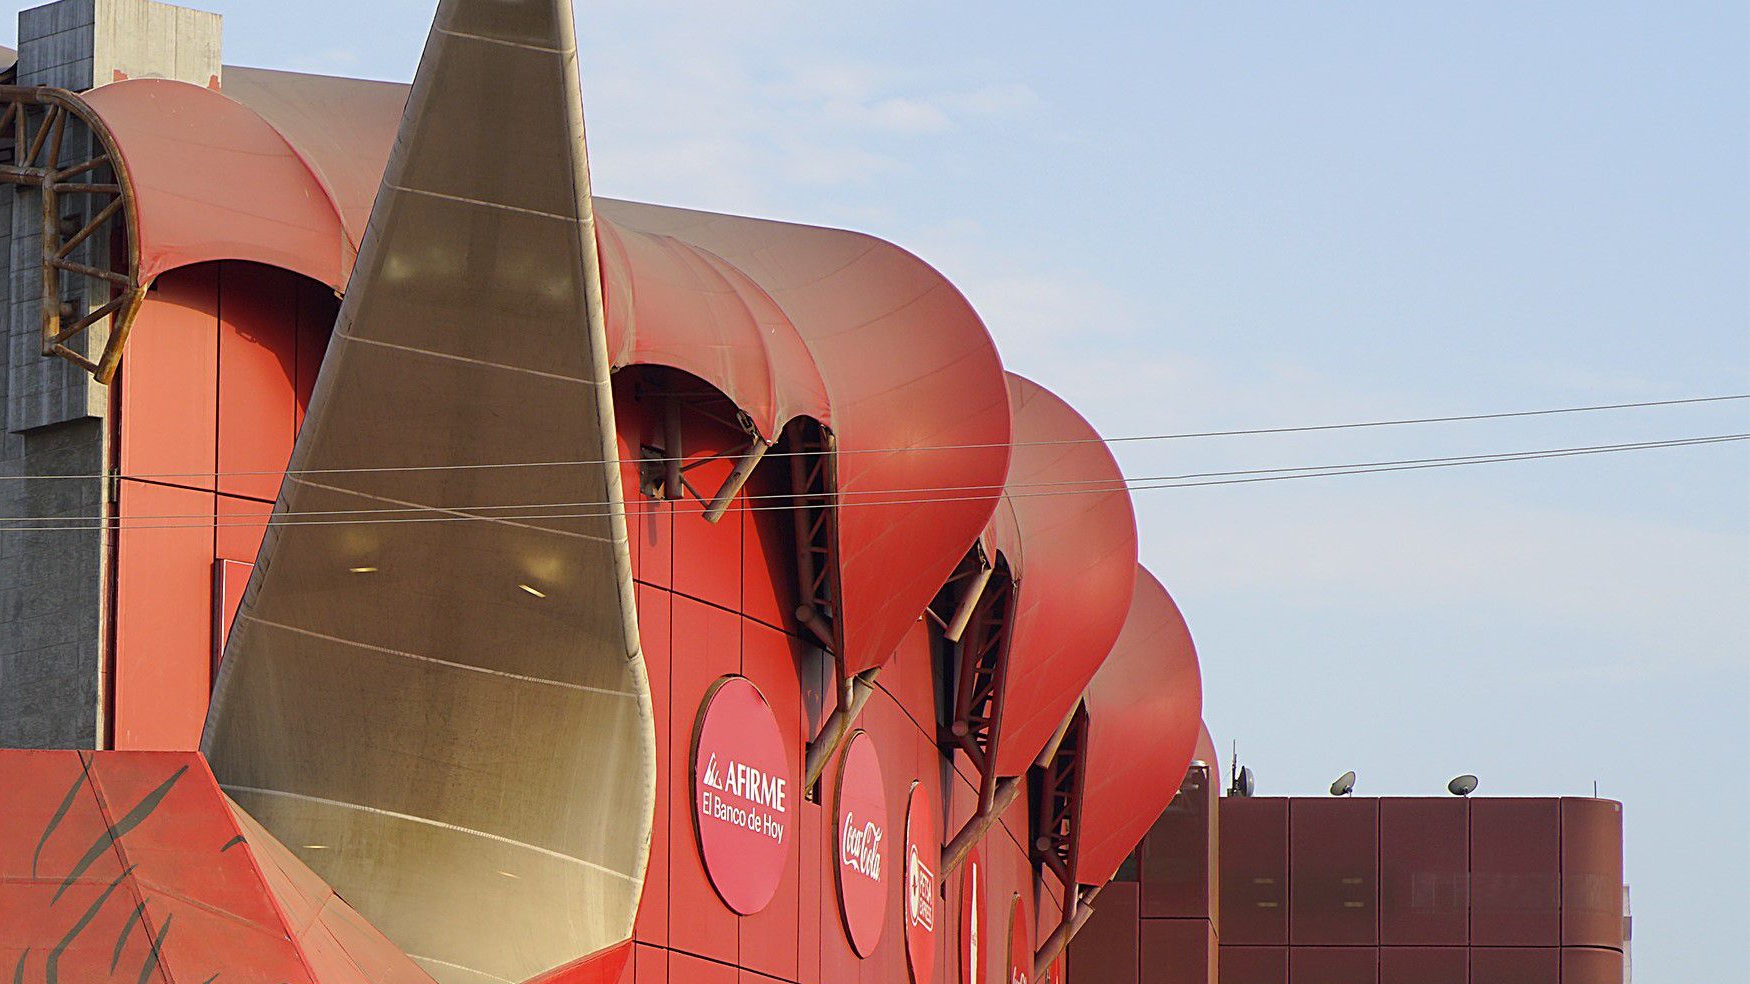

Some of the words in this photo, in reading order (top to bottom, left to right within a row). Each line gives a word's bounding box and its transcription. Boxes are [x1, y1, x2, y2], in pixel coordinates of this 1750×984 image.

[724, 760, 786, 813] AFIRME
[702, 791, 713, 816] El
[714, 795, 747, 827] Banco
[747, 807, 762, 833] de
[763, 813, 784, 844] Hoy
[842, 811, 883, 882] Coca-Cola
